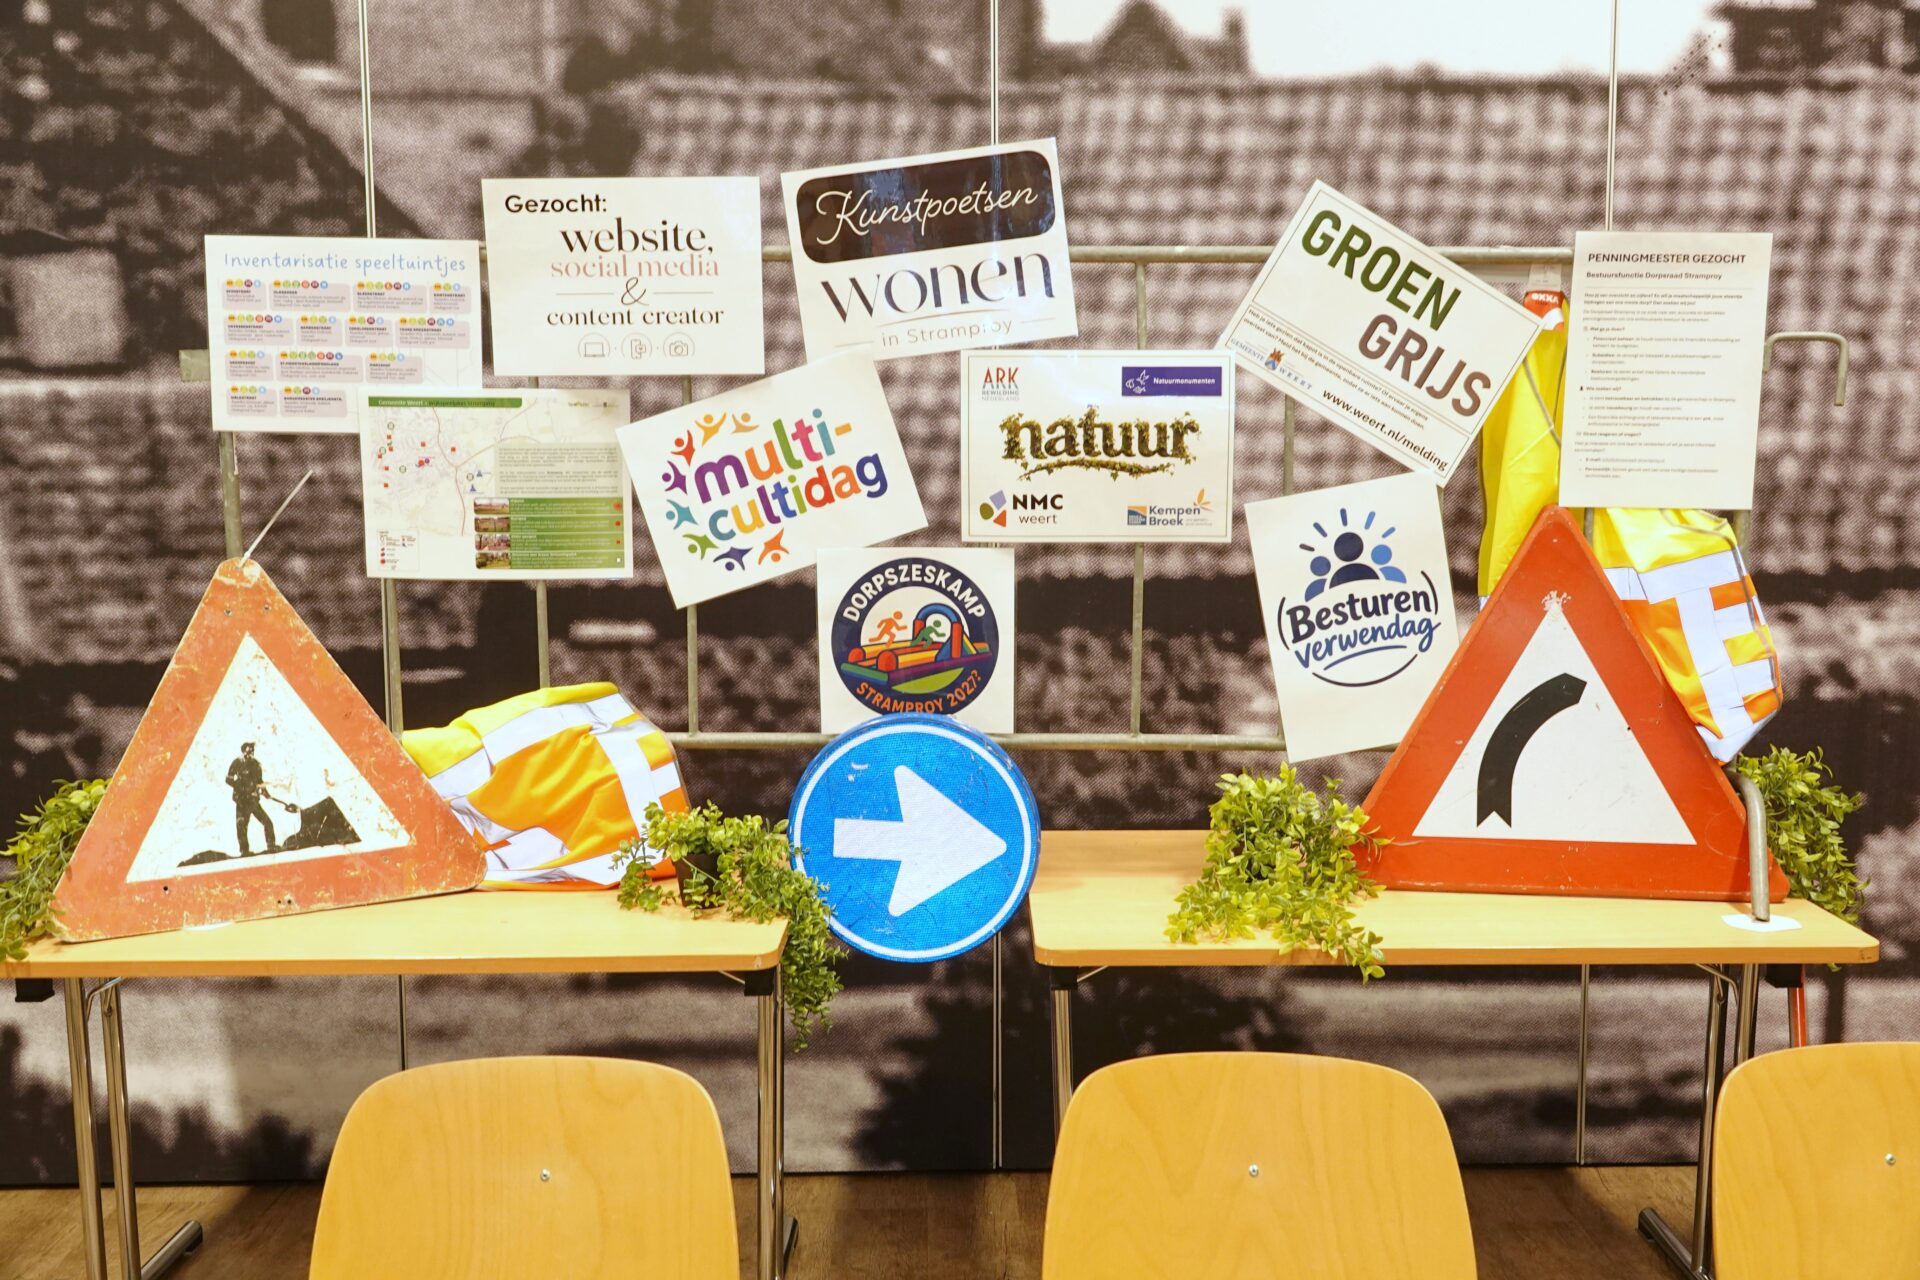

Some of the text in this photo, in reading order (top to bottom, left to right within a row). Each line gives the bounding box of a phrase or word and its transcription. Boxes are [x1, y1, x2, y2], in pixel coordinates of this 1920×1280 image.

[504, 194, 607, 213] Gezocht:
[816, 181, 1038, 246] Kunstpoetsen
[561, 217, 714, 254] website,
[224, 252, 466, 277] Inventarisatie speeltuintjes
[551, 253, 719, 278] social media
[1301, 210, 1462, 331] GROEN
[1588, 253, 1746, 264] PENNINGMEESTER GEZOCHT
[1586, 271, 1722, 280] Bestuursfunctie Dorpsraad Stramproy
[620, 276, 650, 306] &
[547, 307, 724, 326] content creator
[882, 333, 899, 347] in
[982, 367, 1019, 389] ARK
[1277, 366, 1312, 390] WEERT
[1358, 314, 1491, 417] GRIJS
[1153, 377, 1216, 386] Natuurmonumenten
[1000, 406, 1199, 460] natuur
[1322, 388, 1449, 472] www.weert.nl/melding
[694, 408, 852, 504] multi-
[709, 453, 888, 541] cultidag
[1012, 493, 1064, 510] NMC
[1018, 513, 1058, 525] weert
[1149, 505, 1201, 518] Kempen
[1149, 516, 1184, 526] Broek
[843, 564, 986, 622] DORPSZESKAMP
[1286, 590, 1432, 644] Besturen
[1294, 613, 1442, 669] verwendag
[856, 669, 982, 714] STRAMPROY 2027?
